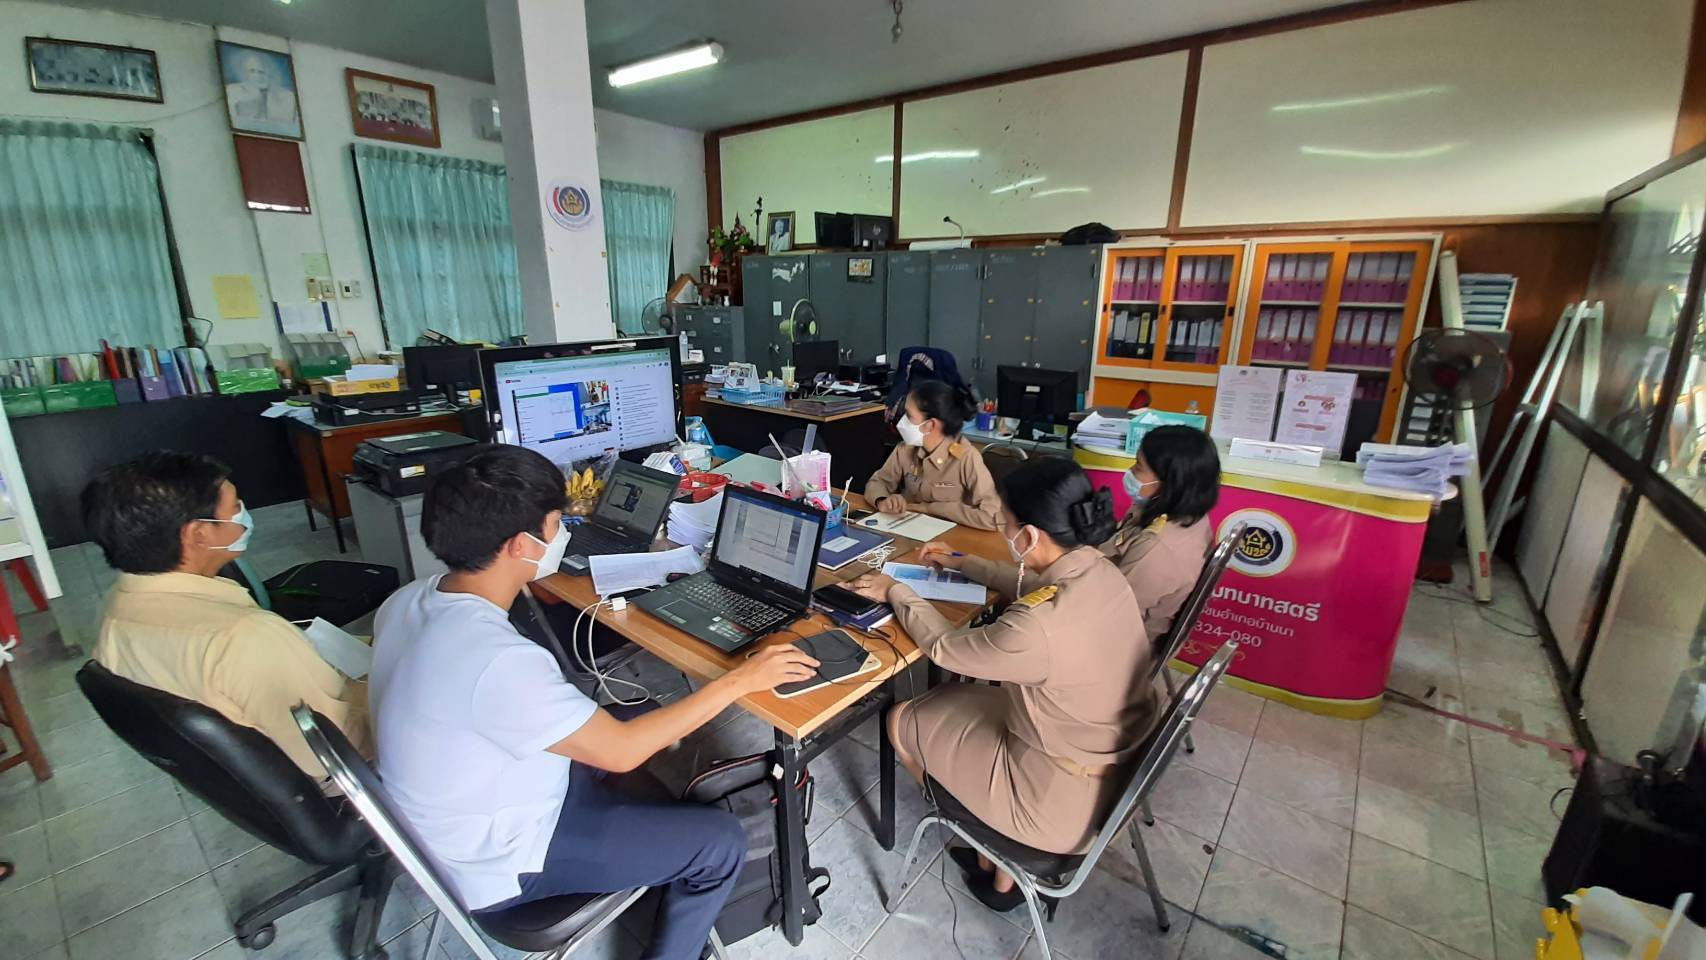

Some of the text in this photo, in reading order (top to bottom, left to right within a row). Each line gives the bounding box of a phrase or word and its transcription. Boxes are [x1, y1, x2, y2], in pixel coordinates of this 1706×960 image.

[1202, 606, 1295, 637] ชนอำเภอบ้านนา
